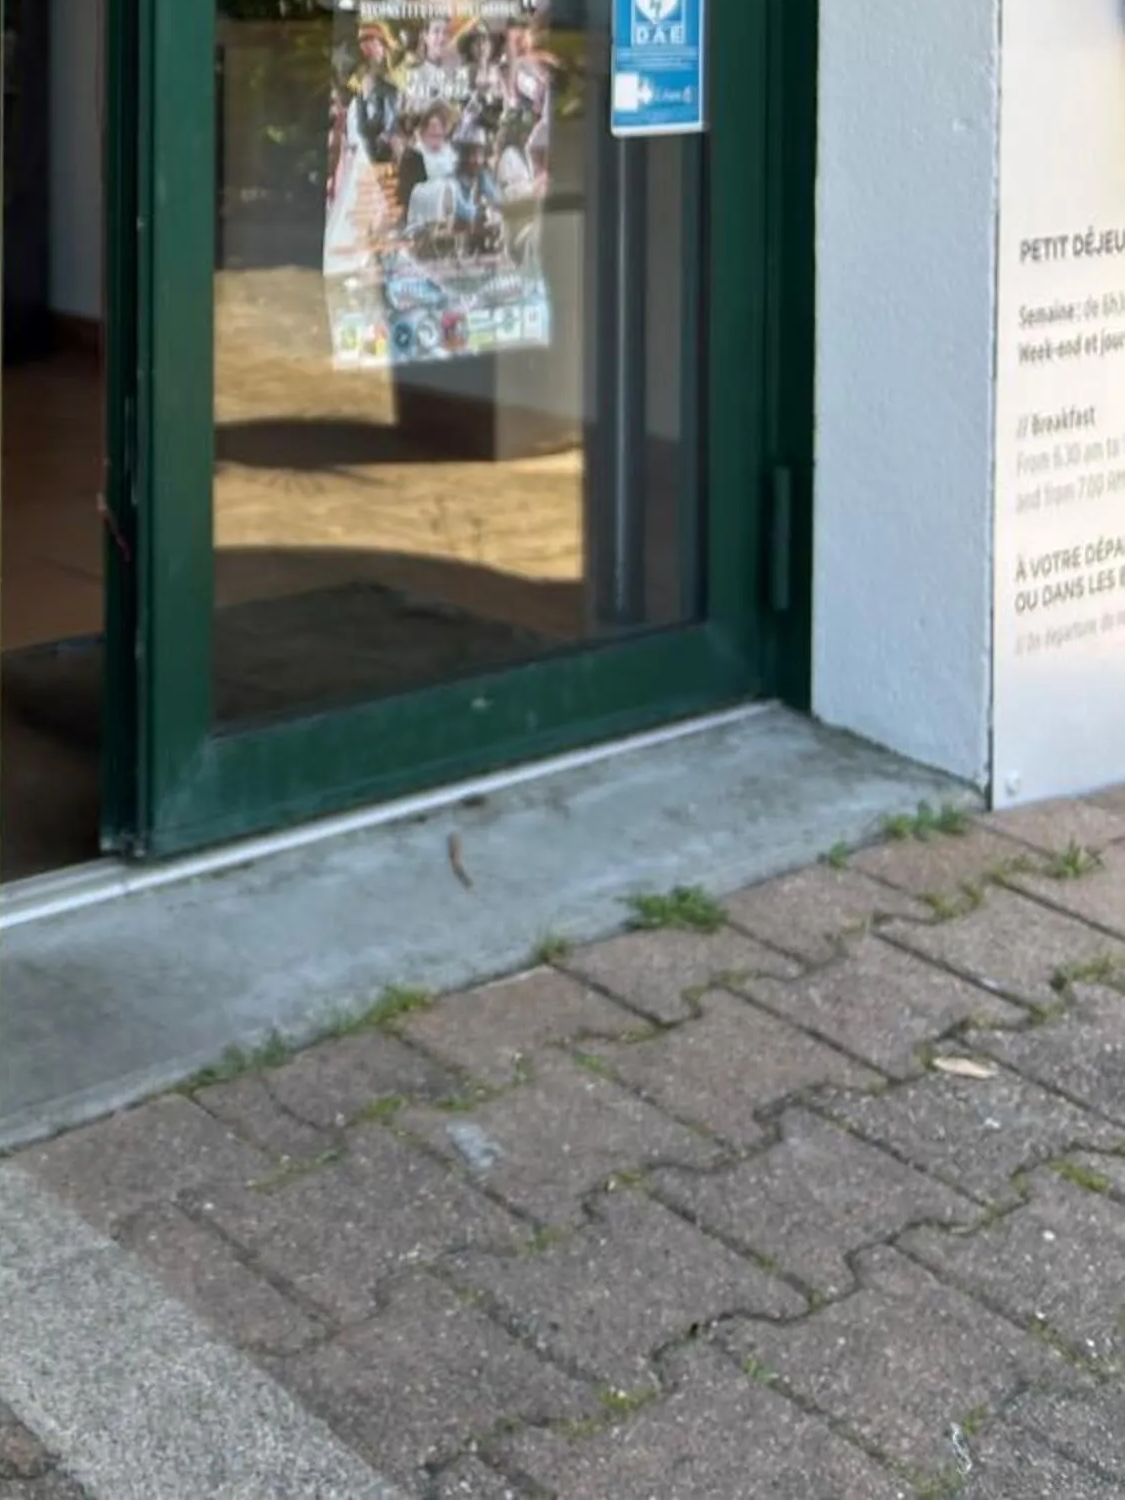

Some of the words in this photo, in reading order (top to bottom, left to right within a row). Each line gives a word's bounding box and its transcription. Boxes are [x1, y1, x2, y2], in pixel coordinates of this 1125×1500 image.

[1019, 234, 1069, 264] PETIT
[1029, 545, 1082, 579] VOTRE
[1015, 589, 1039, 614] OU
[1042, 576, 1084, 607] DANS
[1088, 567, 1116, 596] LES
